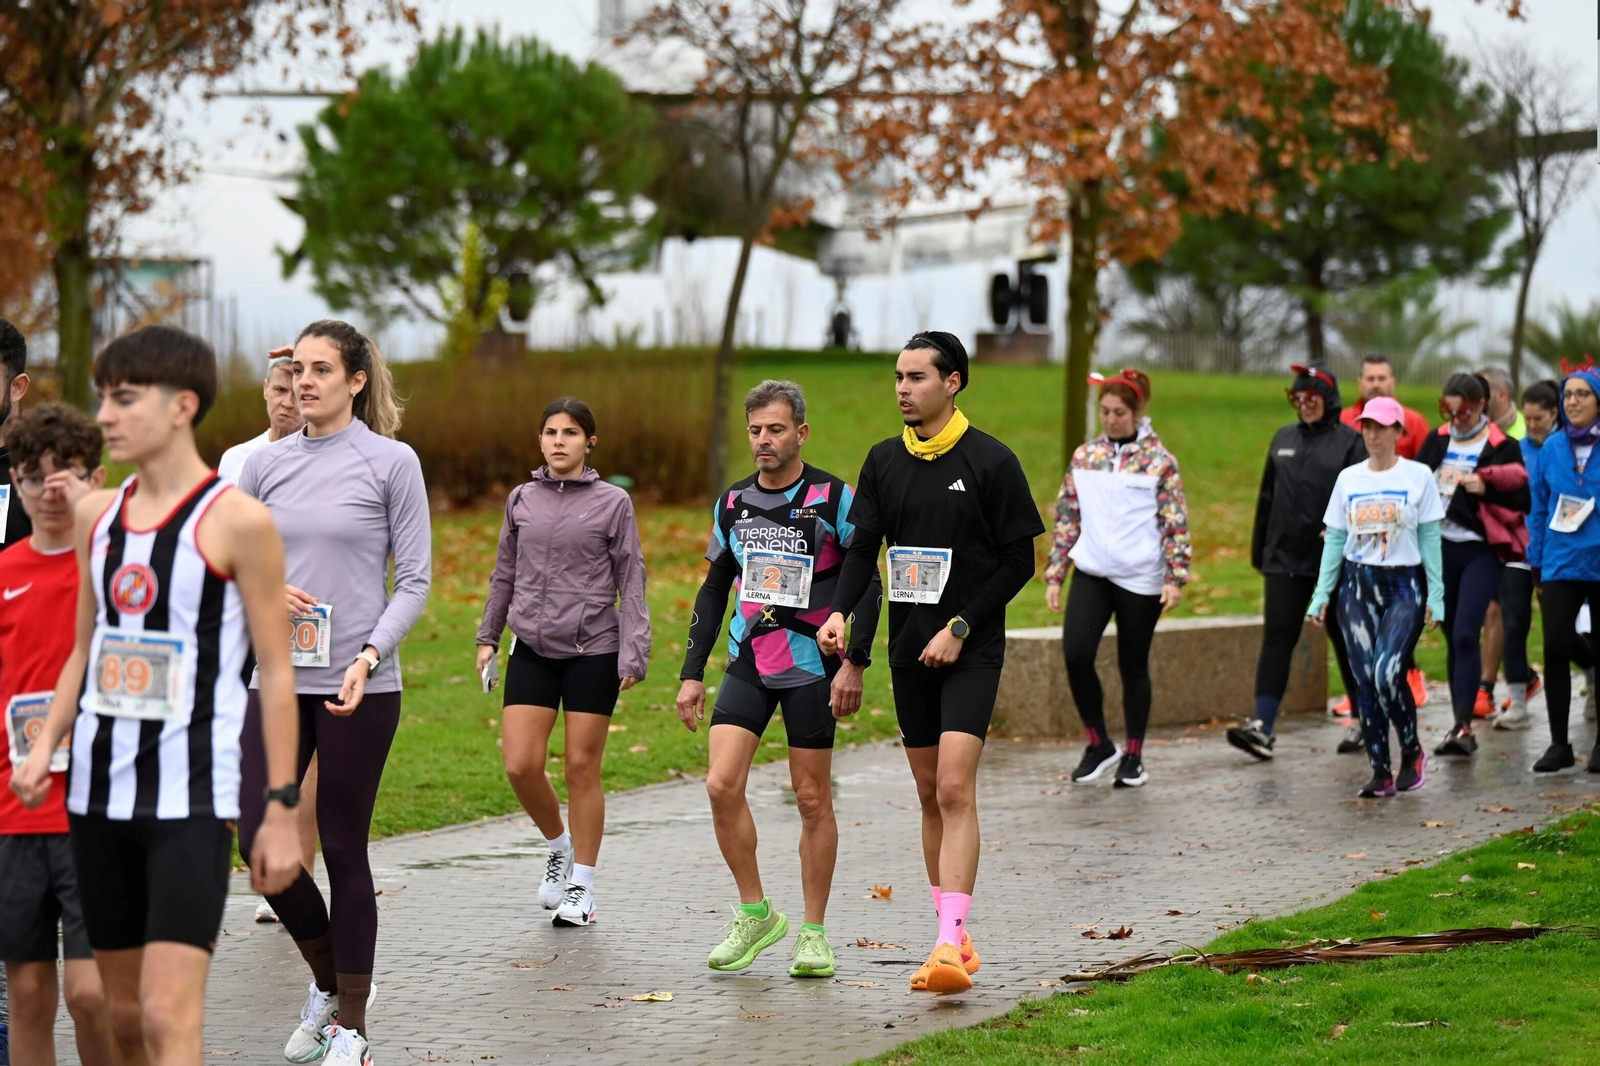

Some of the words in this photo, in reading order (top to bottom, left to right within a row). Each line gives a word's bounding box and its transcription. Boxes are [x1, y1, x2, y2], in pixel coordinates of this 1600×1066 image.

[761, 566, 781, 590] 2
[905, 564, 918, 588] 1
[101, 653, 153, 695] 89
